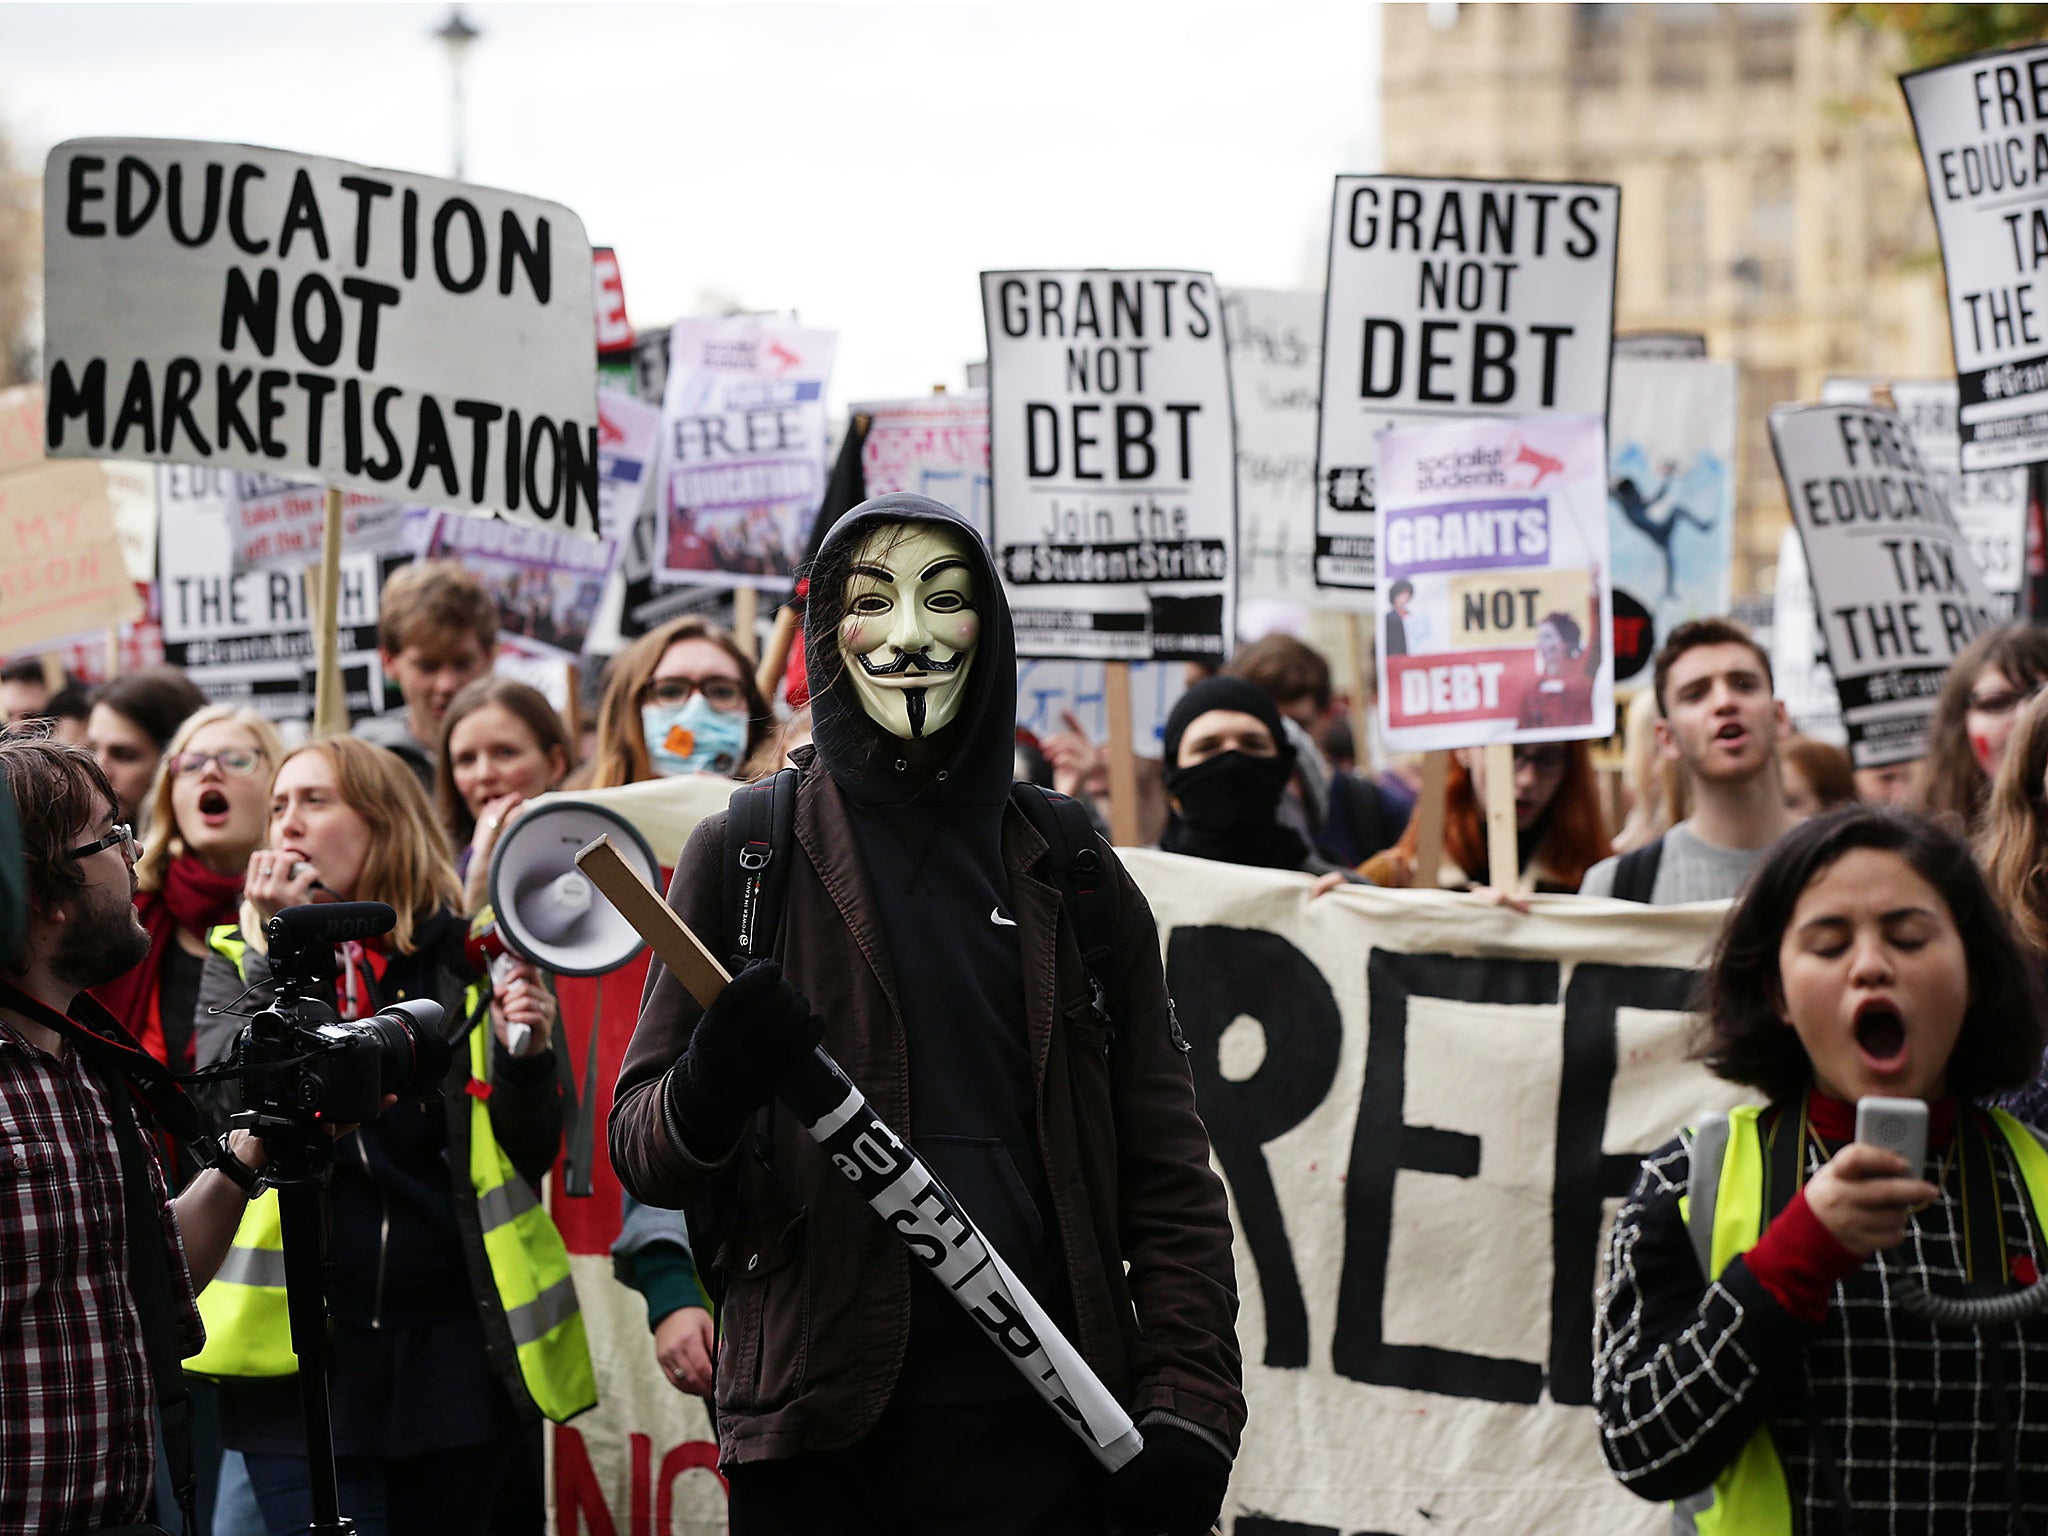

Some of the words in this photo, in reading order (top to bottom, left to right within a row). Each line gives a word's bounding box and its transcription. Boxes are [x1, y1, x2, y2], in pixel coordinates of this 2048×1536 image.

[67, 156, 551, 304] EDUCATION
[1349, 187, 1599, 259] GRANTS
[1001, 279, 1211, 339] GRANTS
[1420, 261, 1519, 313] NOT
[221, 267, 400, 371] NOT
[1963, 284, 2040, 353] THE
[1067, 346, 1150, 394] NOT
[1361, 318, 1574, 407] DEBT
[47, 356, 599, 541] MARKETISATION
[674, 411, 807, 461] FREE
[1026, 403, 1202, 481] DEBT
[1416, 467, 1507, 493] students
[1042, 501, 1113, 543] Join
[1132, 500, 1188, 539] the
[1387, 508, 1548, 566] GRANTS
[1009, 543, 1225, 581] #StudentStrike
[175, 575, 248, 626] THE
[269, 568, 366, 622] RIH
[1464, 589, 1541, 632] NOT
[1833, 602, 1930, 662] THE
[1402, 662, 1505, 717] DEBT
